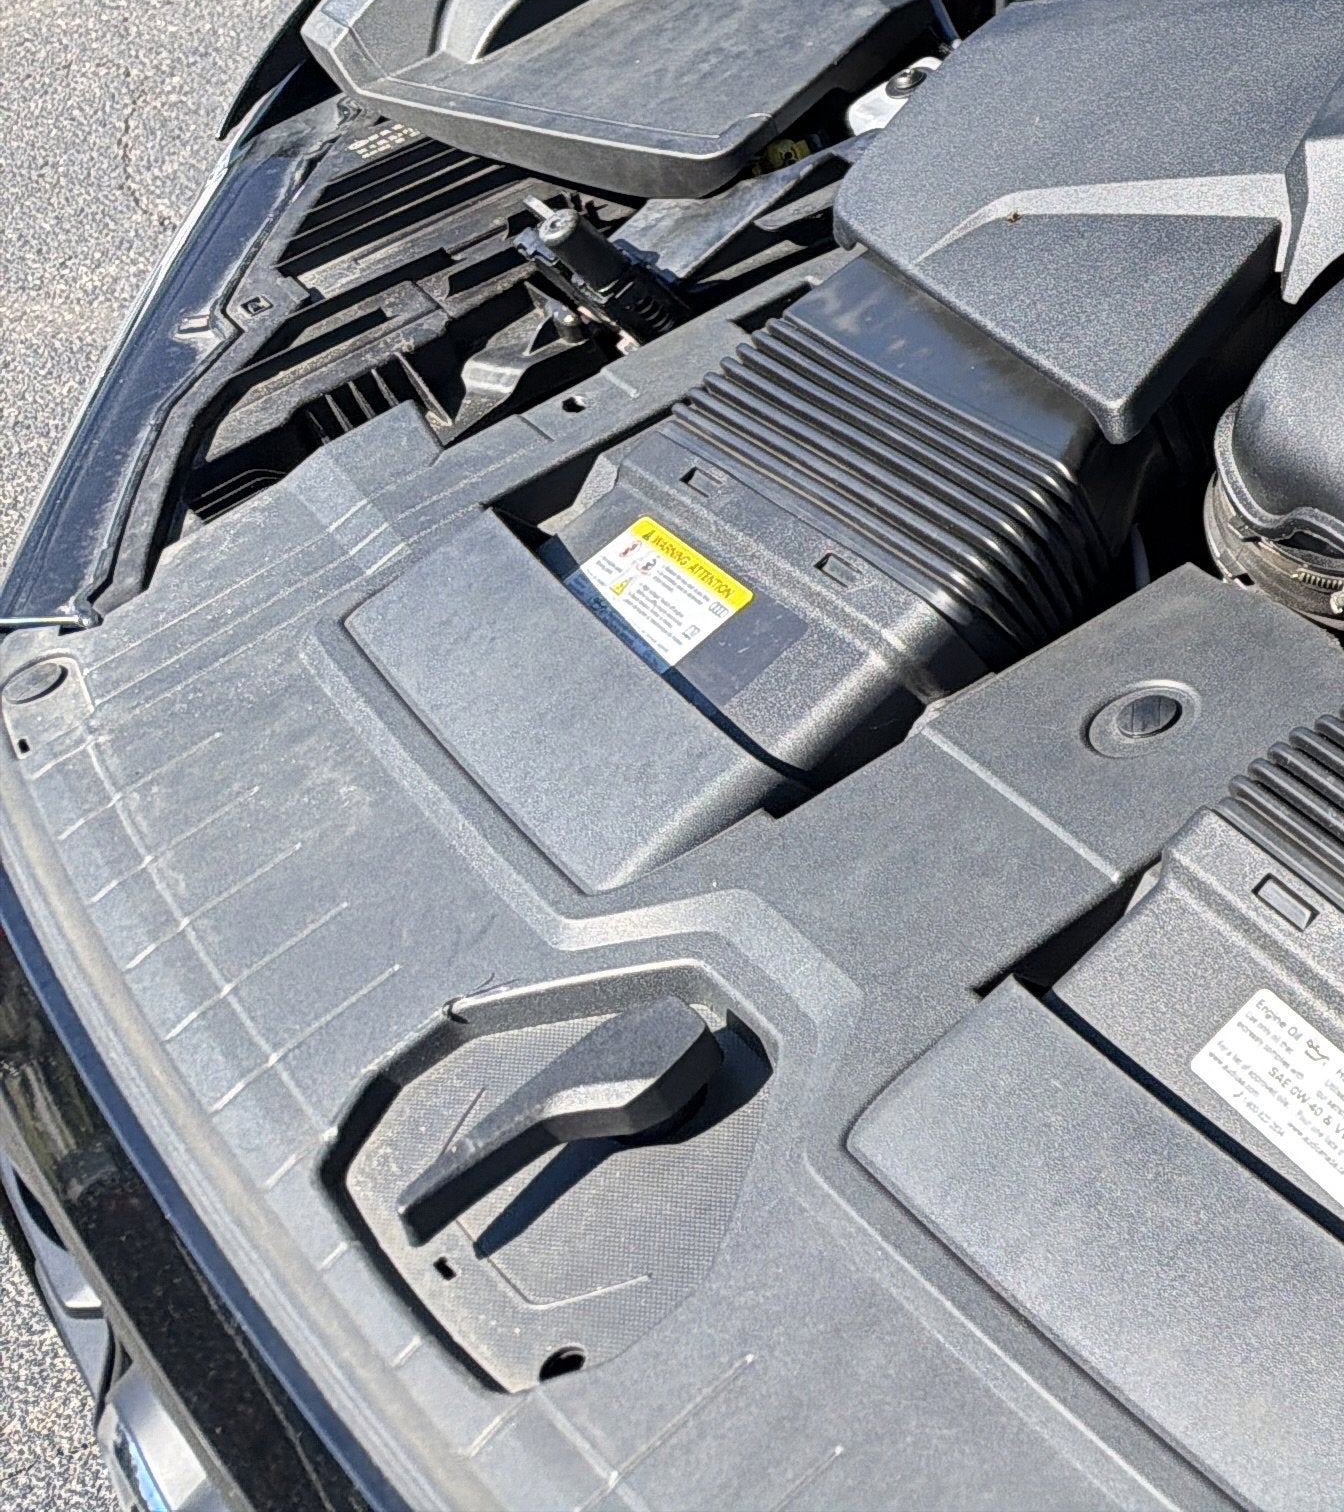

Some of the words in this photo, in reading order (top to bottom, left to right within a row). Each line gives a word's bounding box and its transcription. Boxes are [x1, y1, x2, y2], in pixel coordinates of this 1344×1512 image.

[650, 534, 692, 566] WARNING
[687, 561, 735, 599] ATTENTION
[1253, 998, 1289, 1030] Engine
[1286, 1025, 1303, 1041] Oil
[1267, 1066, 1291, 1088] SAE
